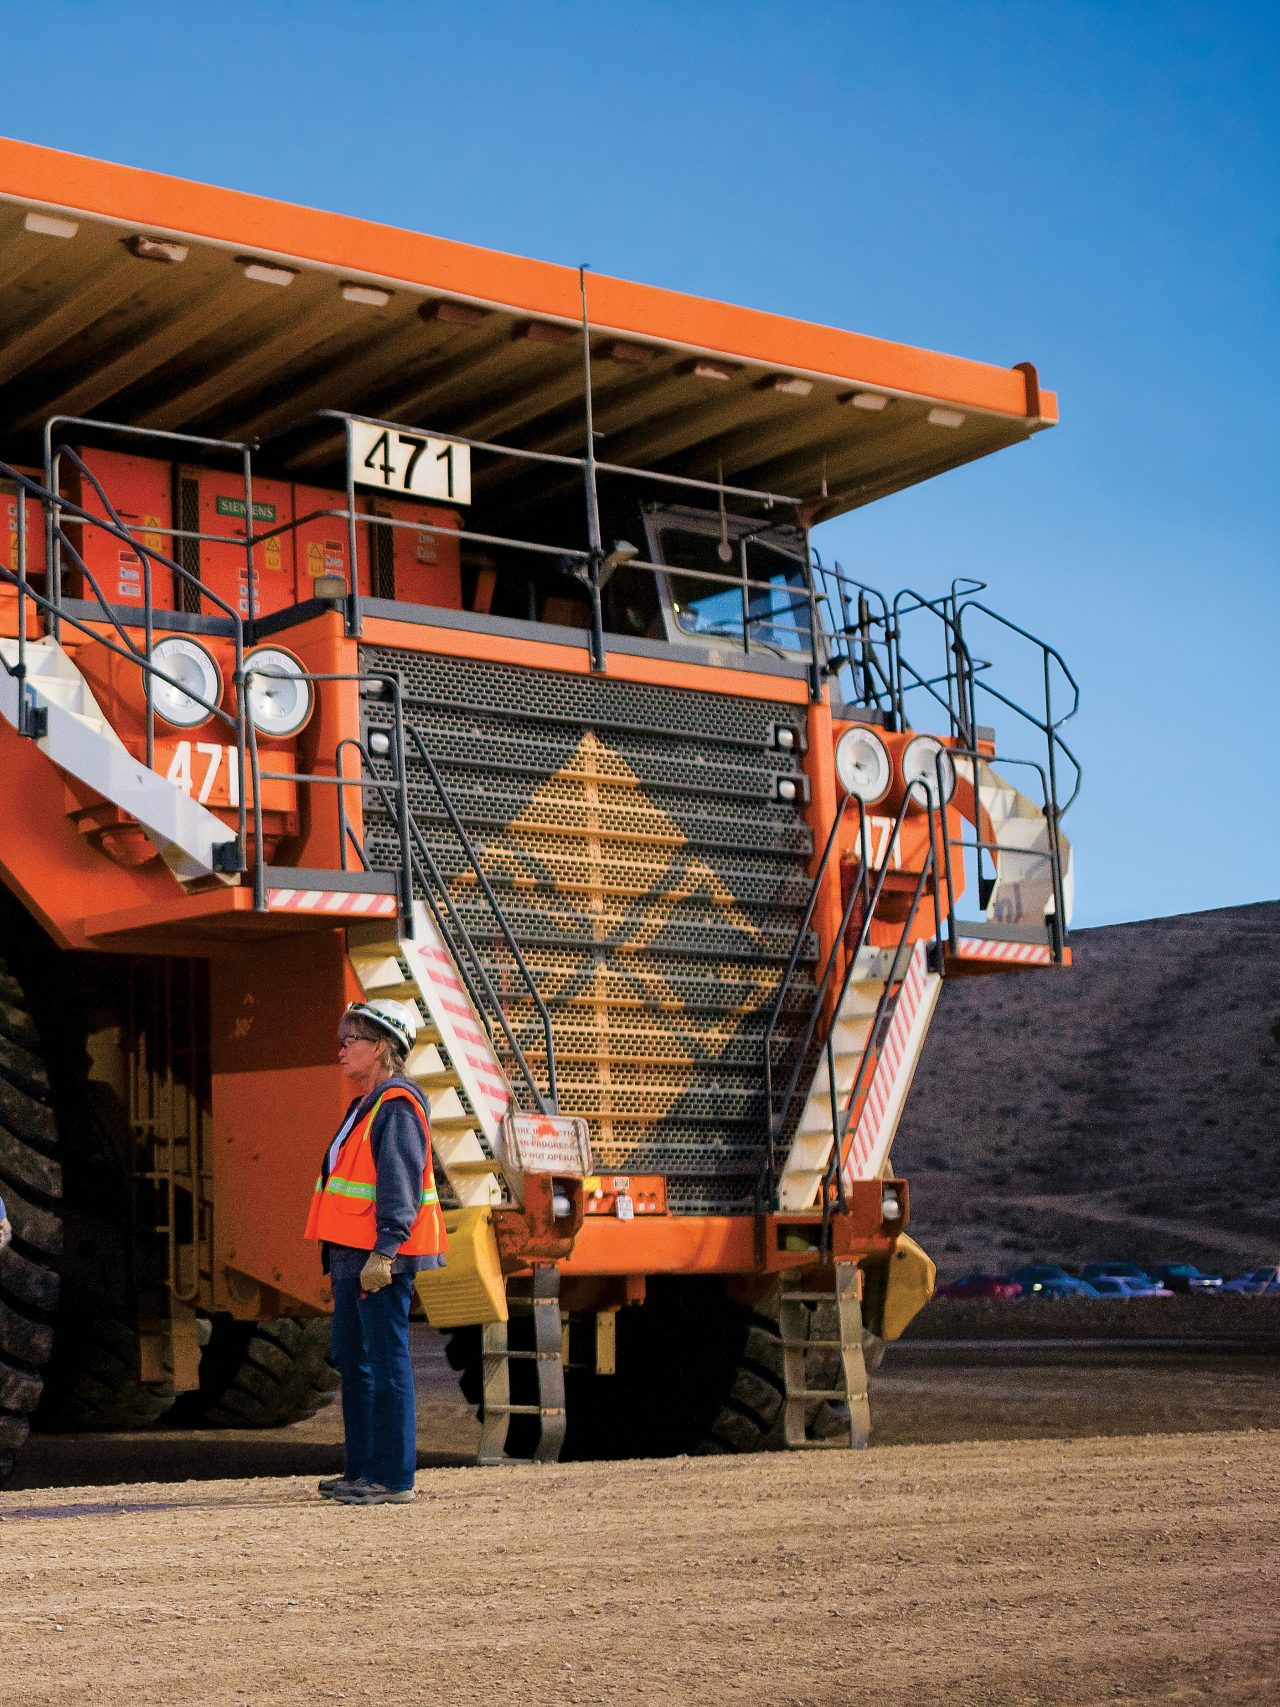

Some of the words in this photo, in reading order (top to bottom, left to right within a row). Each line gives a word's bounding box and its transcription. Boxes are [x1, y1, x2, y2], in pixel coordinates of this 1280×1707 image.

[364, 430, 455, 499] 471
[167, 740, 240, 807] 471
[548, 1153, 581, 1162] OPERAT
